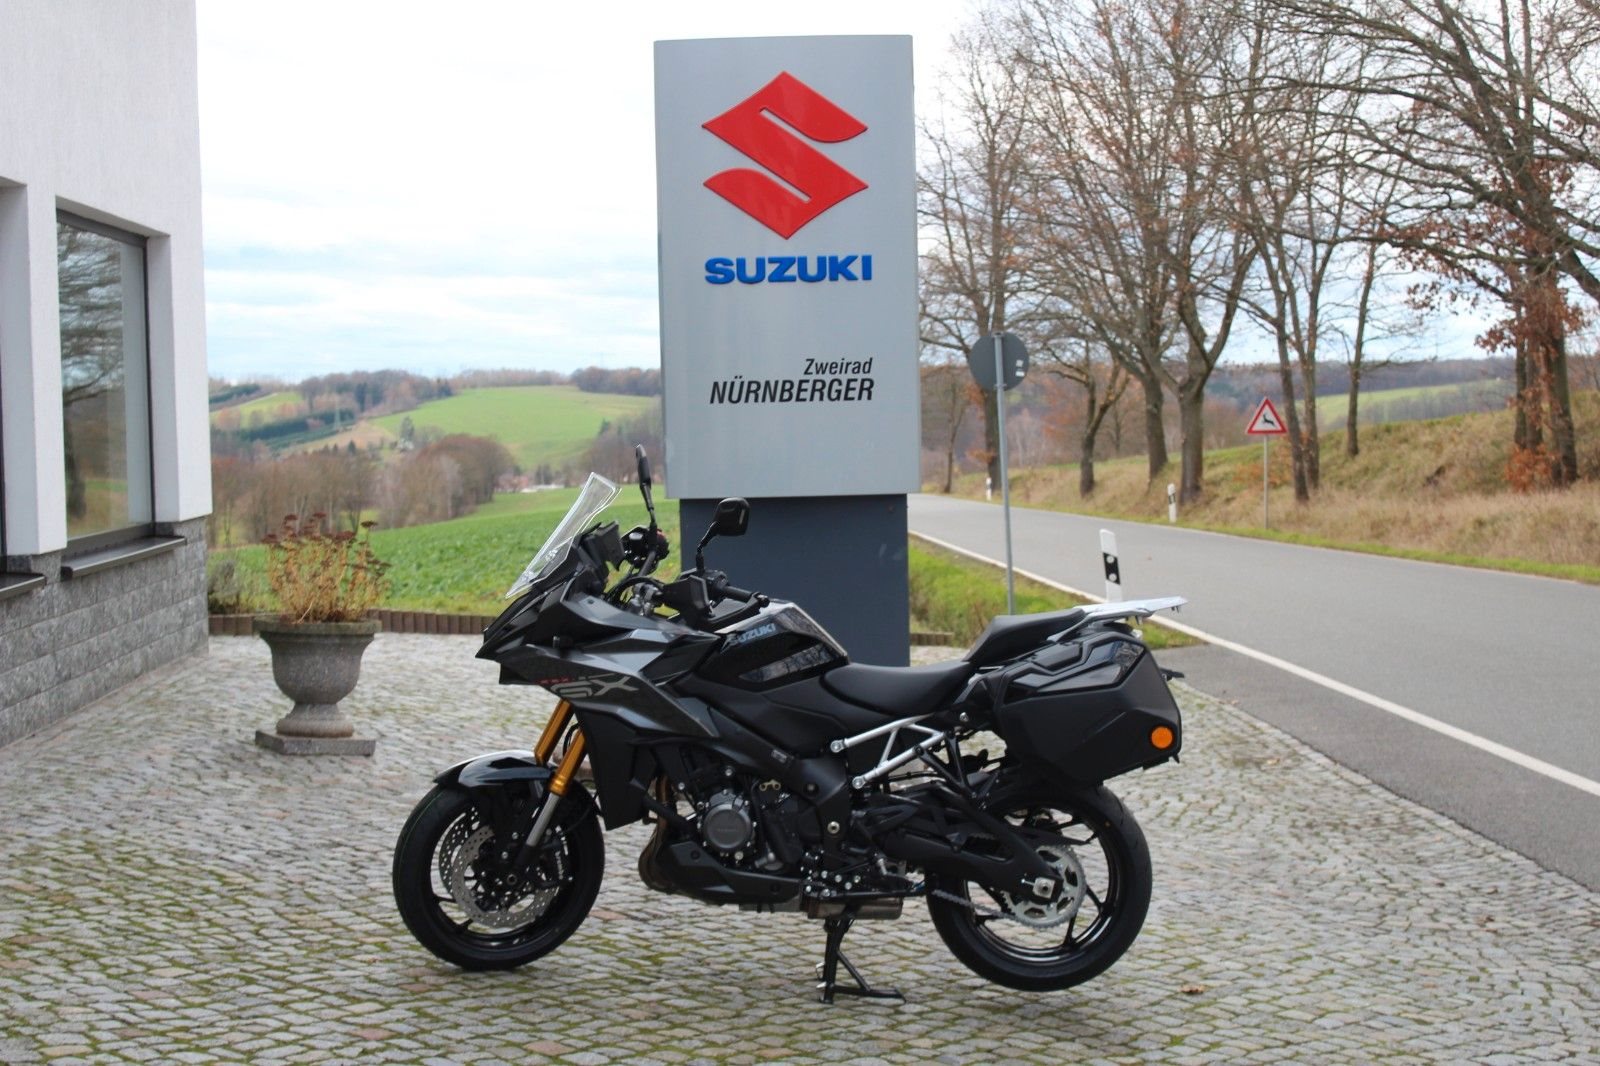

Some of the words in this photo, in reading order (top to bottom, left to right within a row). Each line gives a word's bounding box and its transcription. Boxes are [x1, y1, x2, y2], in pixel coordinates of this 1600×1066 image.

[704, 254, 873, 285] SUZUKI
[803, 357, 873, 376] Zweirad
[709, 375, 875, 404] NÜRNBERGER
